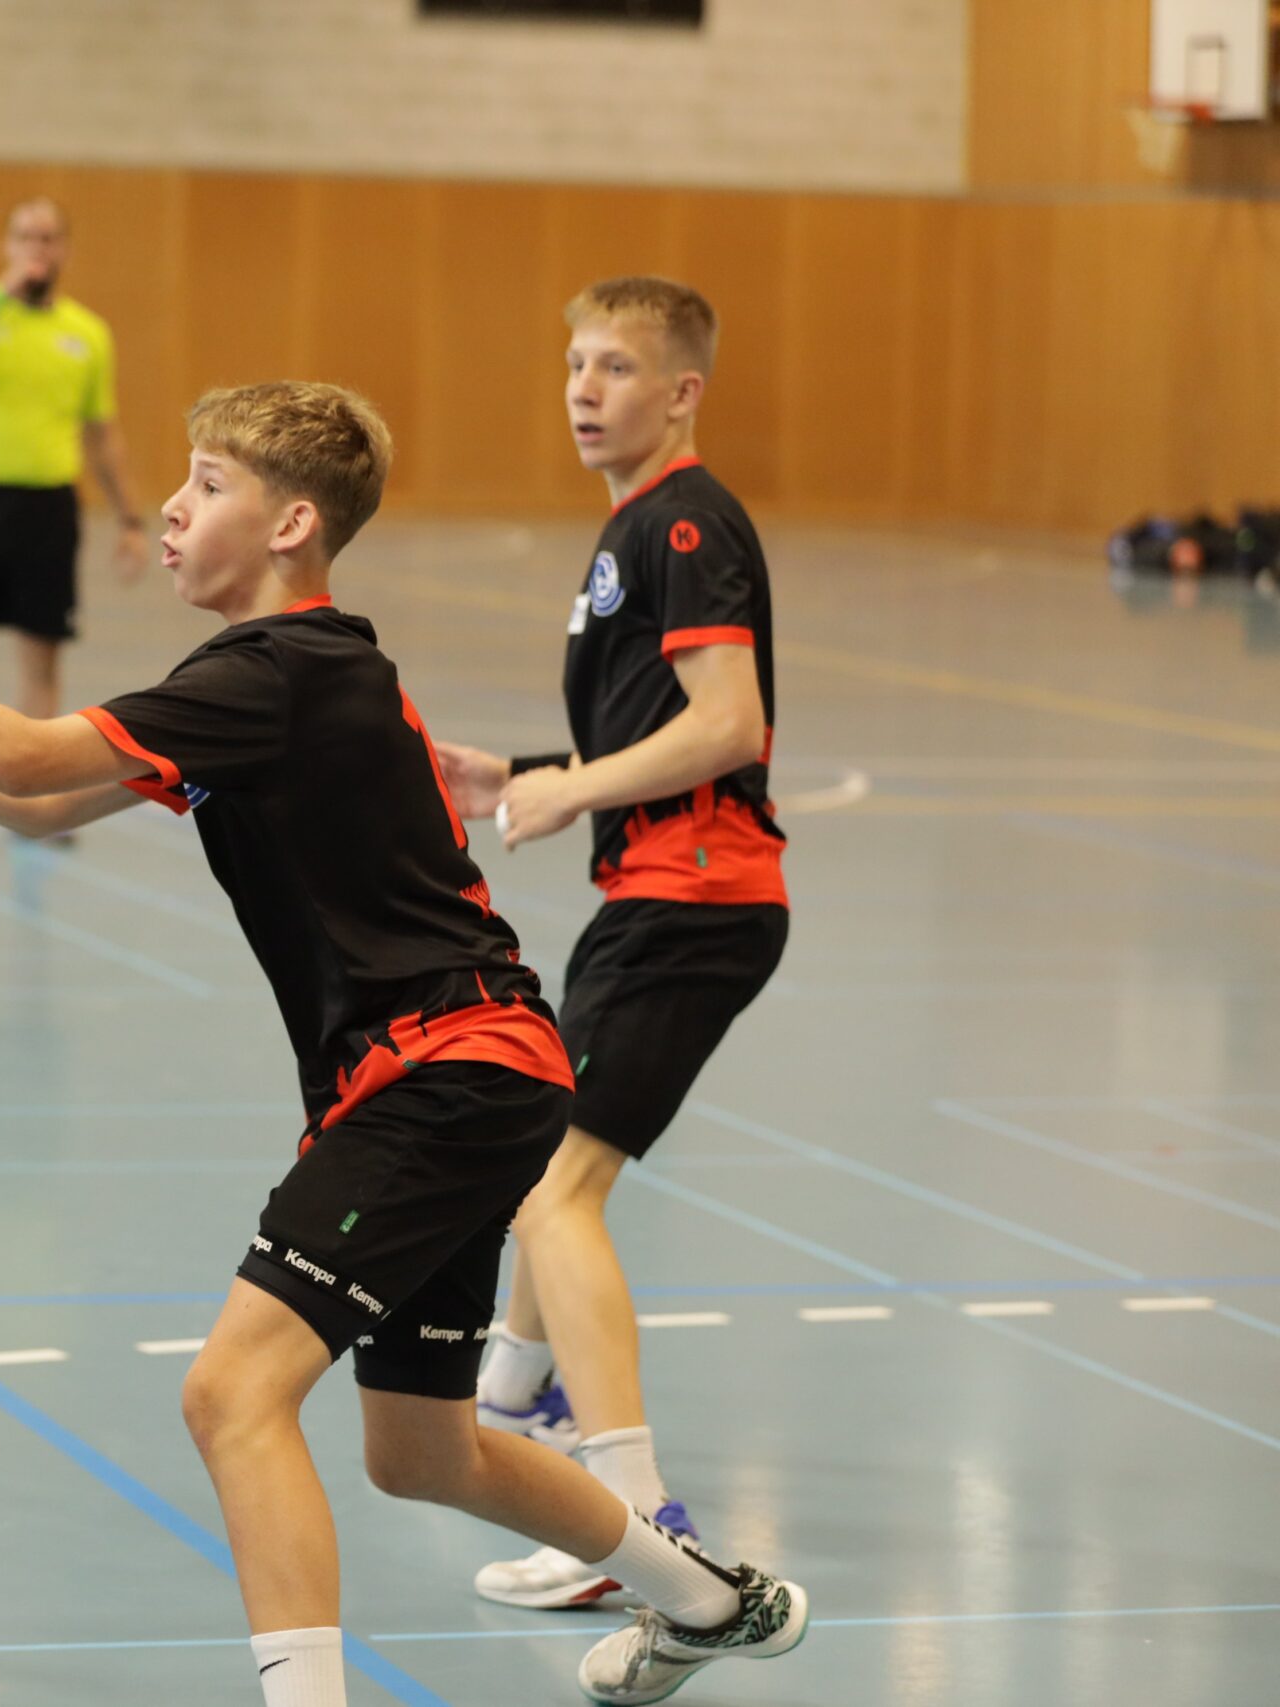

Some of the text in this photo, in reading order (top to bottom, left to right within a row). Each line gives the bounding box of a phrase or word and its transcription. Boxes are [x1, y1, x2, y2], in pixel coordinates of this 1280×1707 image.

[284, 1248, 337, 1286] Kempa
[346, 1282, 384, 1315] Kempa
[419, 1325, 465, 1343] Kempa
